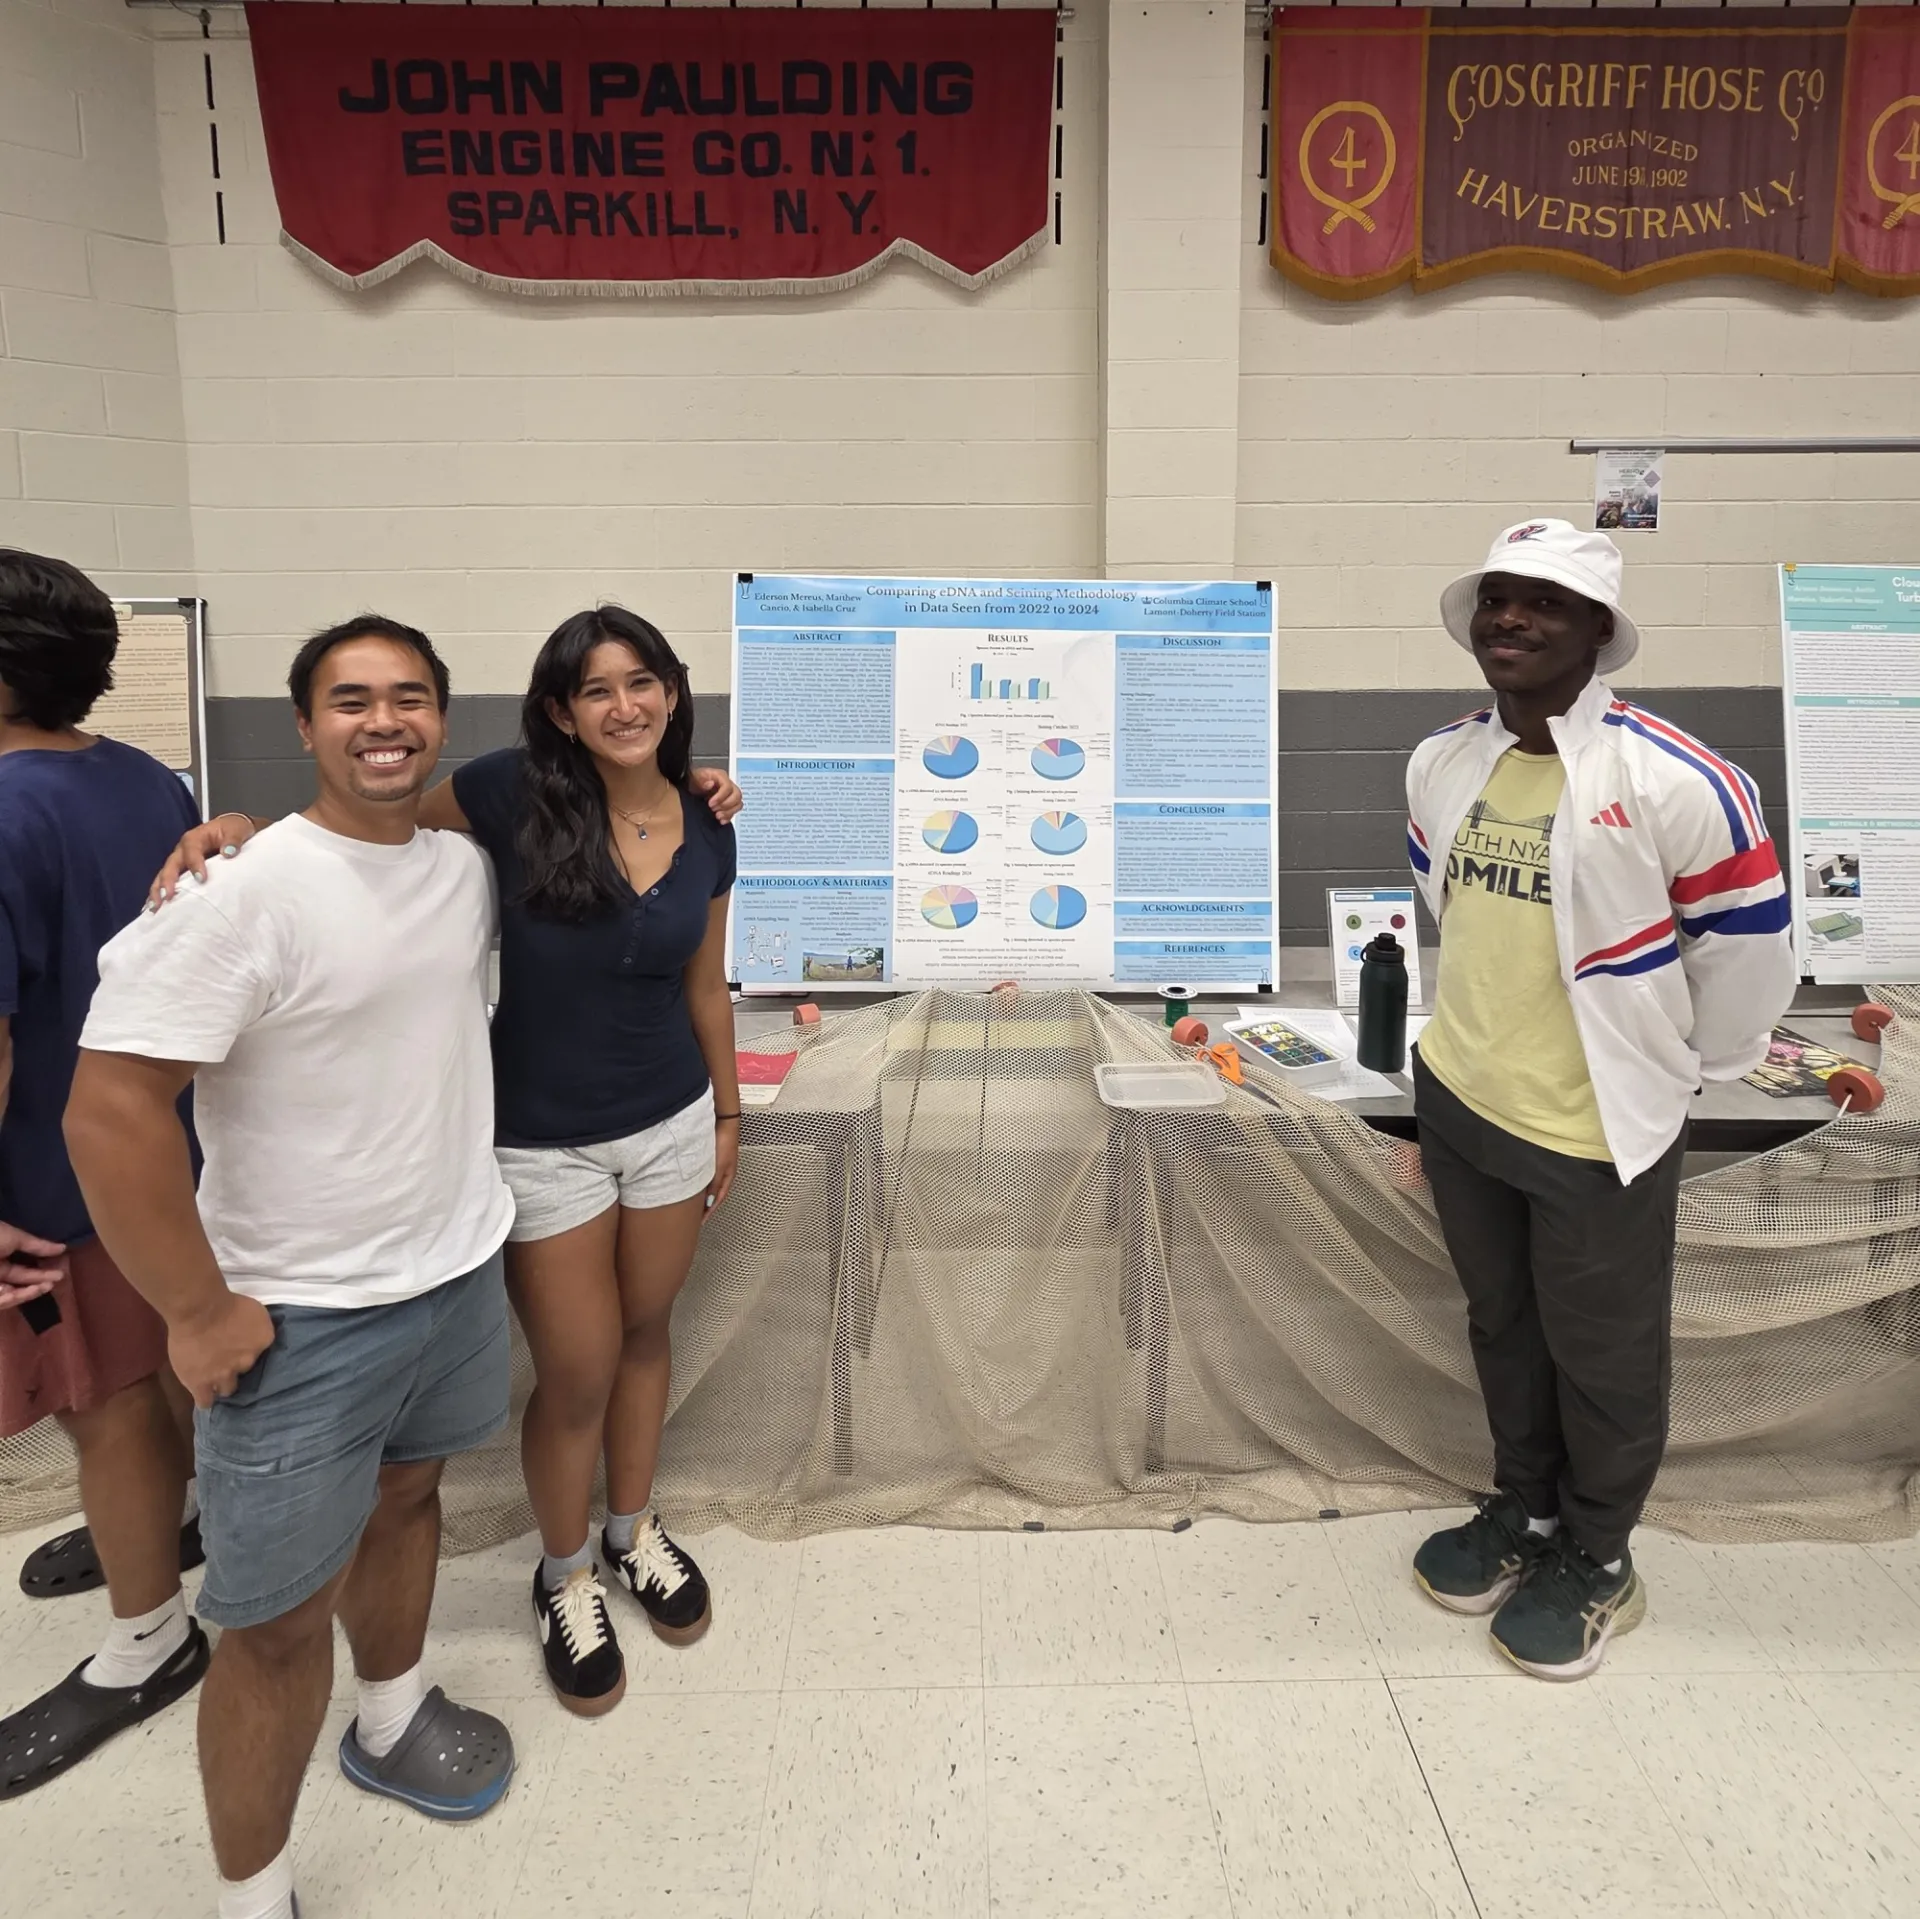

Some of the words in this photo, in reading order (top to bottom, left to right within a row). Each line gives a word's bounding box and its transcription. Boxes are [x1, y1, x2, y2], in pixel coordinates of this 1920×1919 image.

[338, 58, 562, 115] JOHN
[589, 61, 974, 116] PAULDING
[1448, 63, 1652, 141] COSGRIFF
[1663, 66, 1764, 111] HOSE
[1568, 130, 1698, 161] ORGANIZED
[401, 130, 665, 178] ENGINE
[693, 130, 793, 178] CO.
[896, 130, 931, 176] 1.
[1329, 126, 1366, 187] 4
[1572, 165, 1619, 186] JUNE
[1651, 168, 1688, 187] 1902
[1738, 185, 1777, 224] N.
[1770, 169, 1803, 207] Y.
[447, 189, 739, 240] SPARKILL,
[774, 190, 820, 235] N.
[836, 189, 880, 235] Y.
[754, 592, 788, 602] Ederson
[791, 592, 824, 603] Mereus,
[826, 593, 862, 603] Matthew
[866, 585, 937, 600] Comparing
[939, 587, 977, 598] eDNA
[980, 587, 1002, 599] and
[1006, 587, 1053, 601] Seining
[1056, 588, 1138, 602] Methodology
[1152, 596, 1194, 606] Columbia
[1196, 597, 1228, 606] Climate
[1230, 597, 1257, 607] School
[760, 604, 791, 614] Cancio,
[793, 604, 800, 613] &
[802, 604, 834, 613] Isabella
[836, 604, 857, 613] Cruz
[904, 602, 918, 613] in
[921, 602, 949, 613] Data
[951, 602, 981, 614] Seen
[984, 603, 1015, 614] from
[1019, 604, 1050, 615] 2022
[1053, 604, 1066, 615] to
[1069, 604, 1100, 616] 2024
[1143, 608, 1214, 619] Lamont-Doherty
[1216, 608, 1236, 617] Field
[1238, 609, 1266, 618] Station
[793, 633, 842, 642] ABSTRACT
[987, 634, 1029, 643] RESULTS
[1162, 637, 1221, 647] DISCUSSION
[777, 760, 855, 770] INTRODUCTION
[1159, 805, 1225, 814] CONCLUSION
[740, 878, 819, 887] METHODOLOGY
[822, 878, 831, 887] &
[833, 878, 888, 887] MATERIALS
[1164, 944, 1226, 953] REFERENCES
